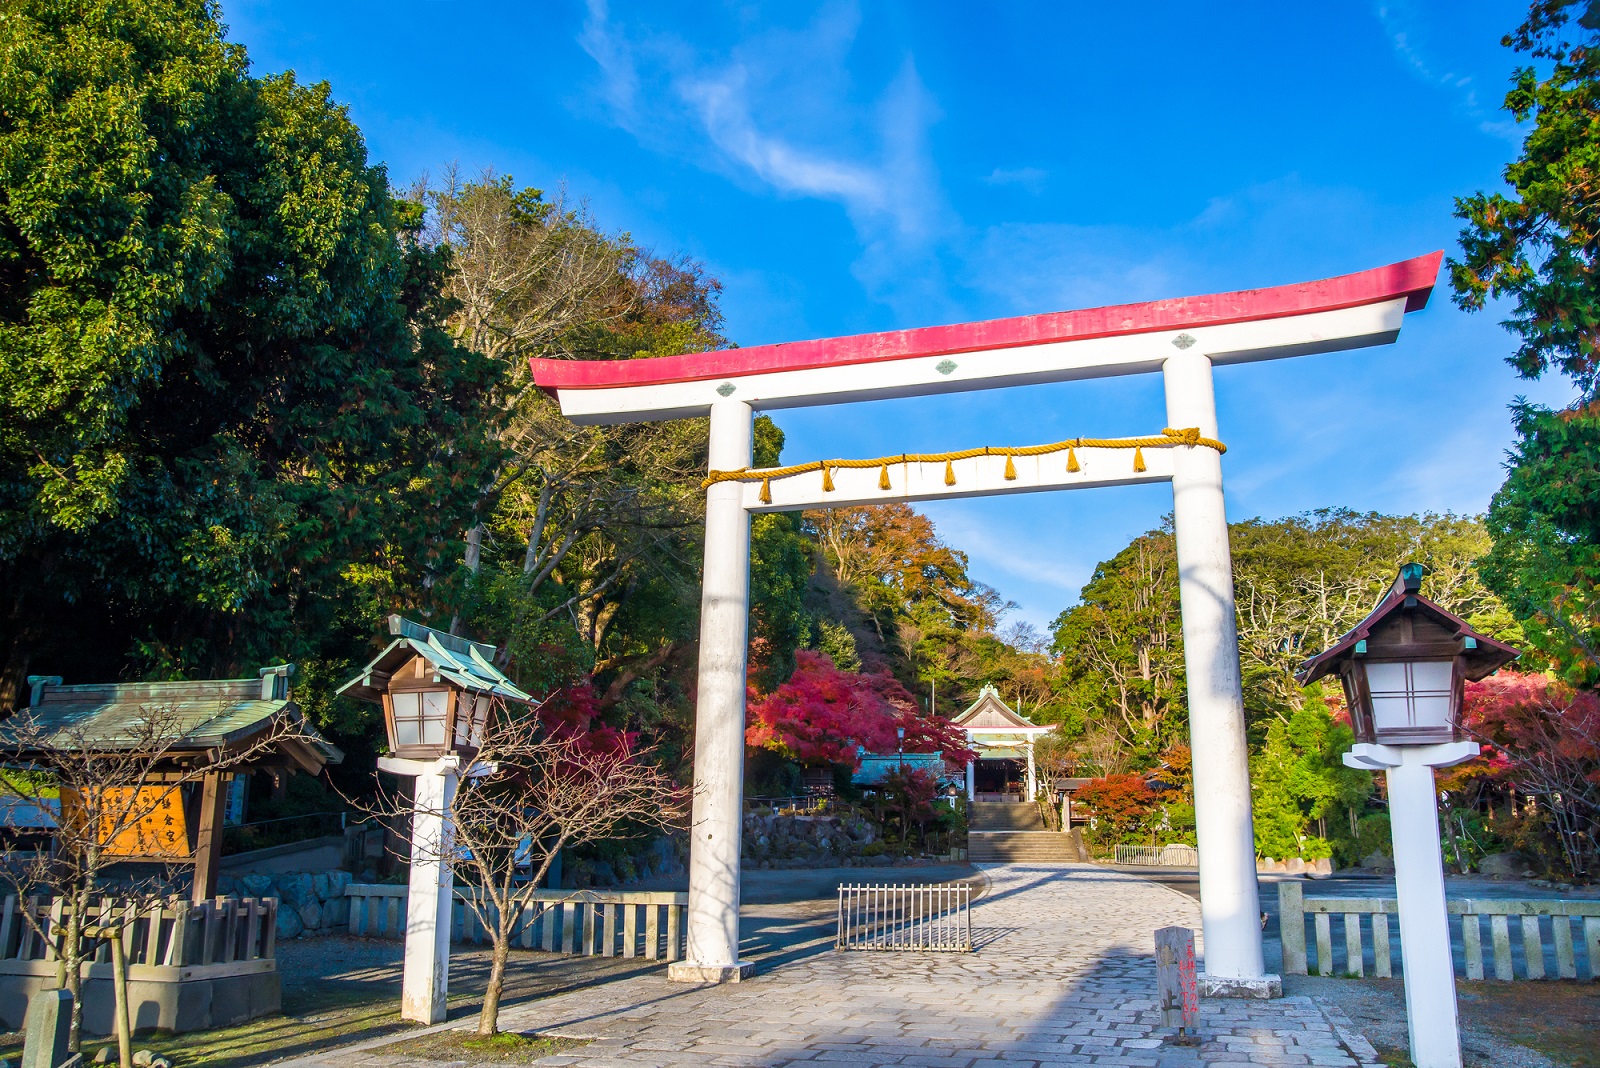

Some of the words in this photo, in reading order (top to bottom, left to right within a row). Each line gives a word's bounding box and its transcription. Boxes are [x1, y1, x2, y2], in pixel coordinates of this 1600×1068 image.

[1186, 938, 1199, 1014] ご参拝の方のみ
